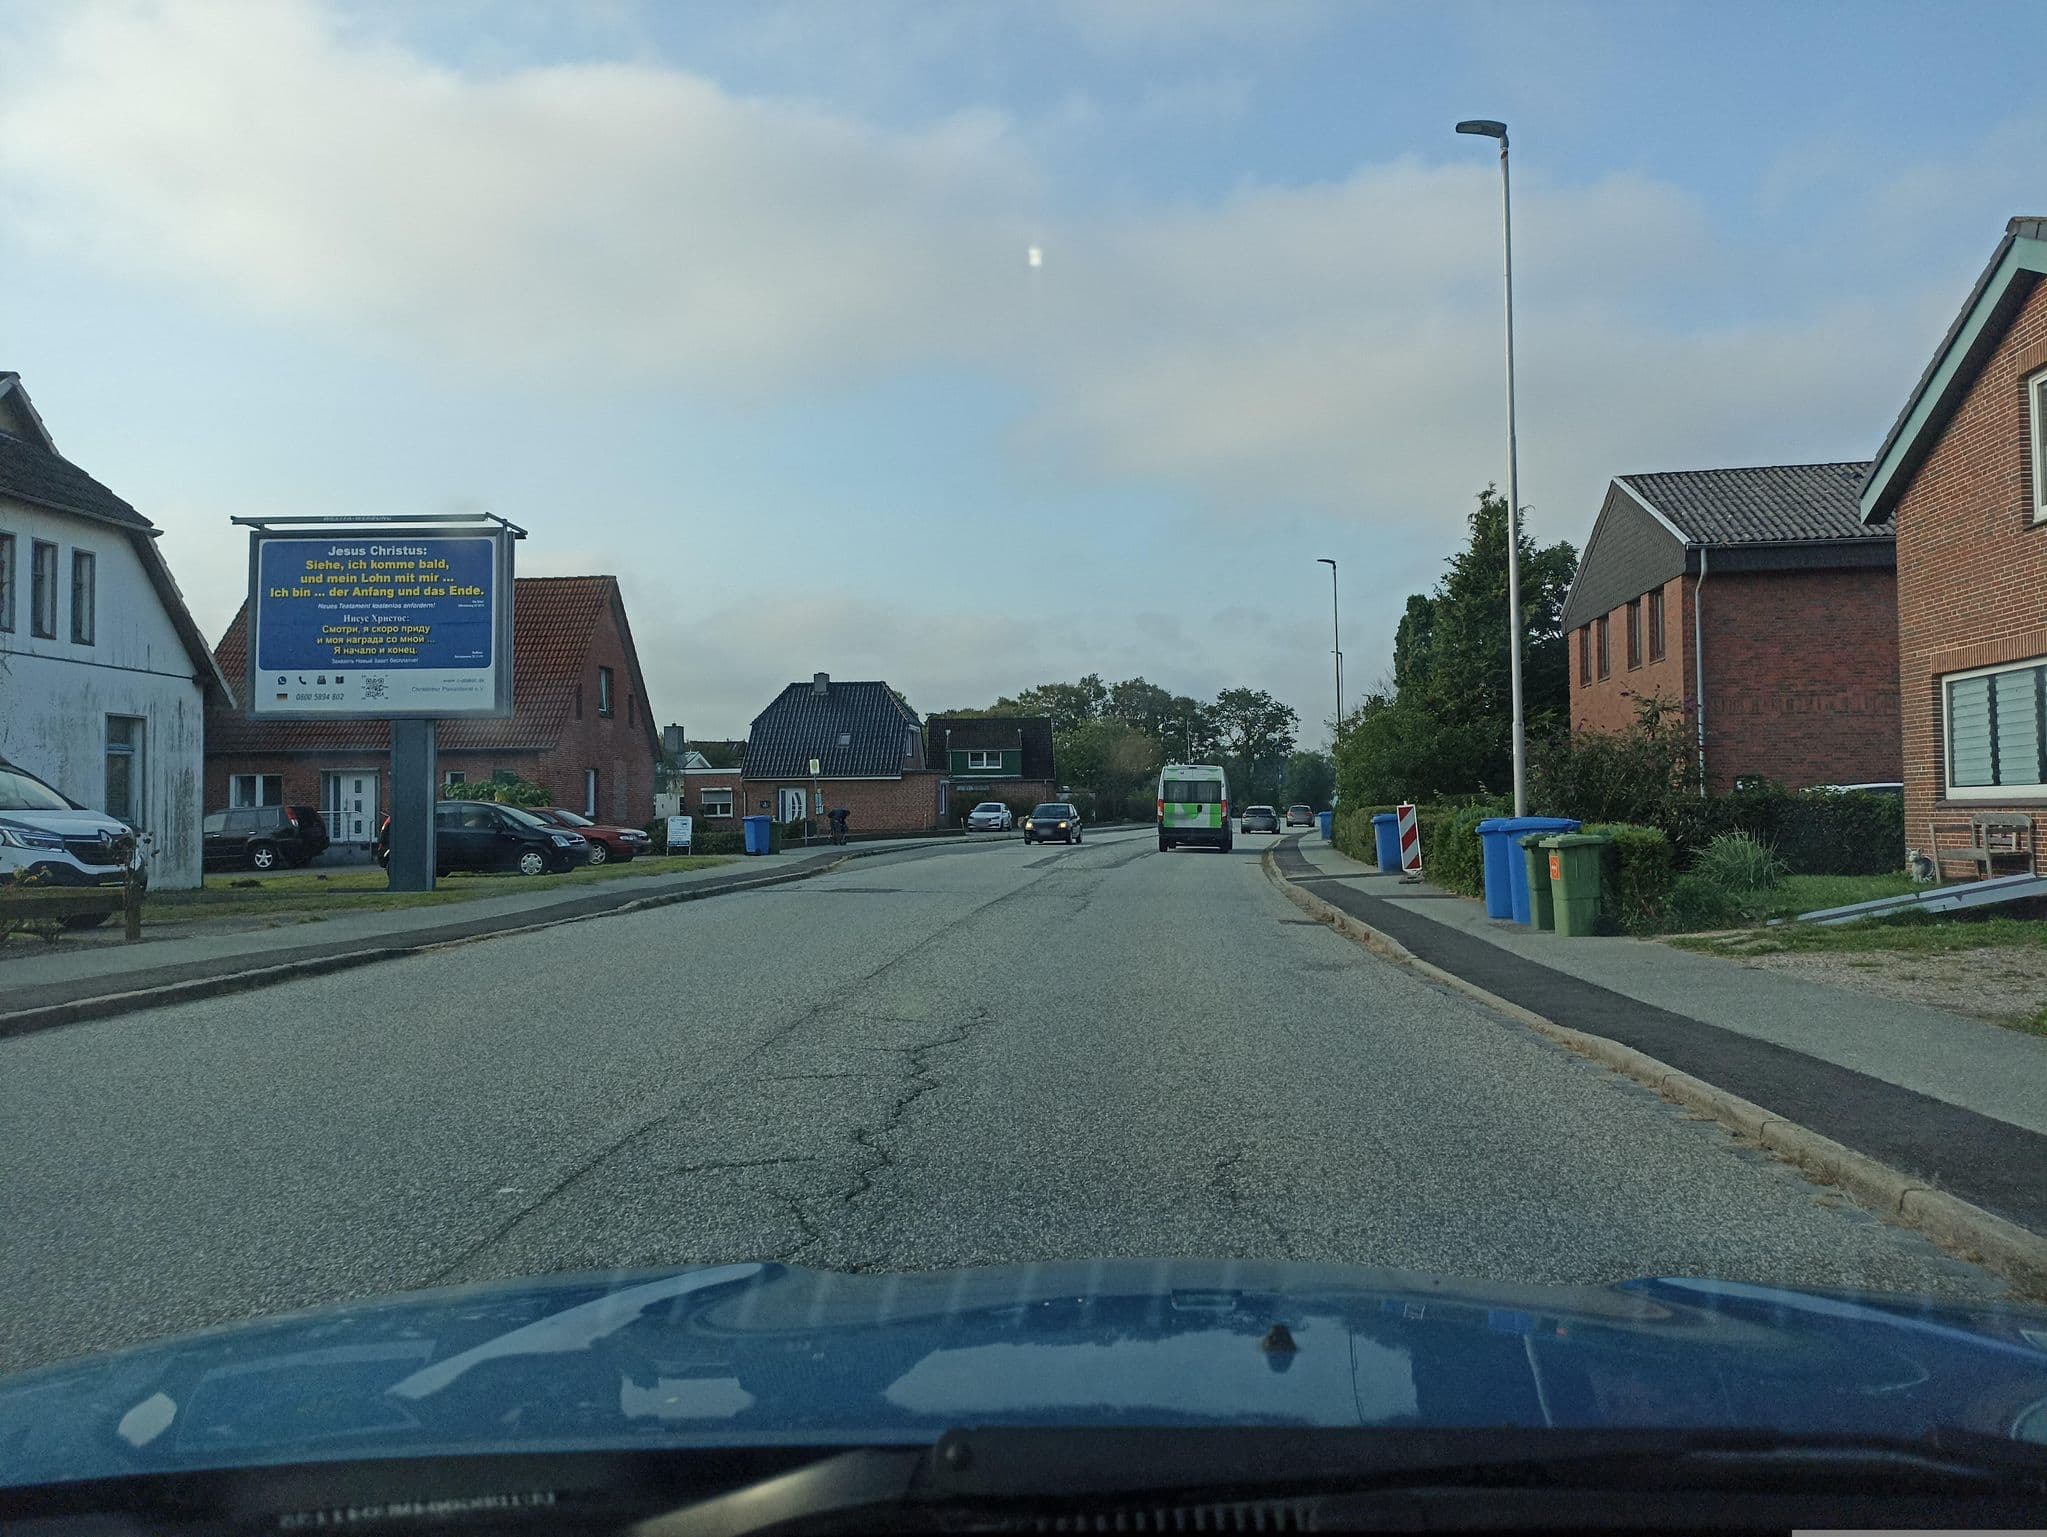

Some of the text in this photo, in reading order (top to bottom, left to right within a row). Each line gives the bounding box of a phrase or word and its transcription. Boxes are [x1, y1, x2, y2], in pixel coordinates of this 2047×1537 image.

[328, 545, 428, 556] Jesus Christus:
[305, 559, 449, 571] Siehe, ich komme bald,
[300, 573, 323, 583] und
[327, 573, 357, 583] mein
[361, 573, 391, 583] Lohn
[394, 573, 415, 582] mit
[418, 573, 440, 582] mir
[270, 587, 289, 597] Ich
[292, 587, 311, 597] bin
[329, 587, 349, 597] der
[352, 586, 395, 598] Anfang
[398, 586, 420, 596] und
[423, 586, 445, 596] das
[449, 585, 485, 596] Ende.
[371, 614, 411, 624] Христос:
[371, 626, 399, 634] скоро
[401, 625, 431, 634] приду
[346, 637, 384, 645] награда
[400, 634, 425, 643] мной
[334, 646, 341, 654] Я
[343, 647, 377, 655] начало
